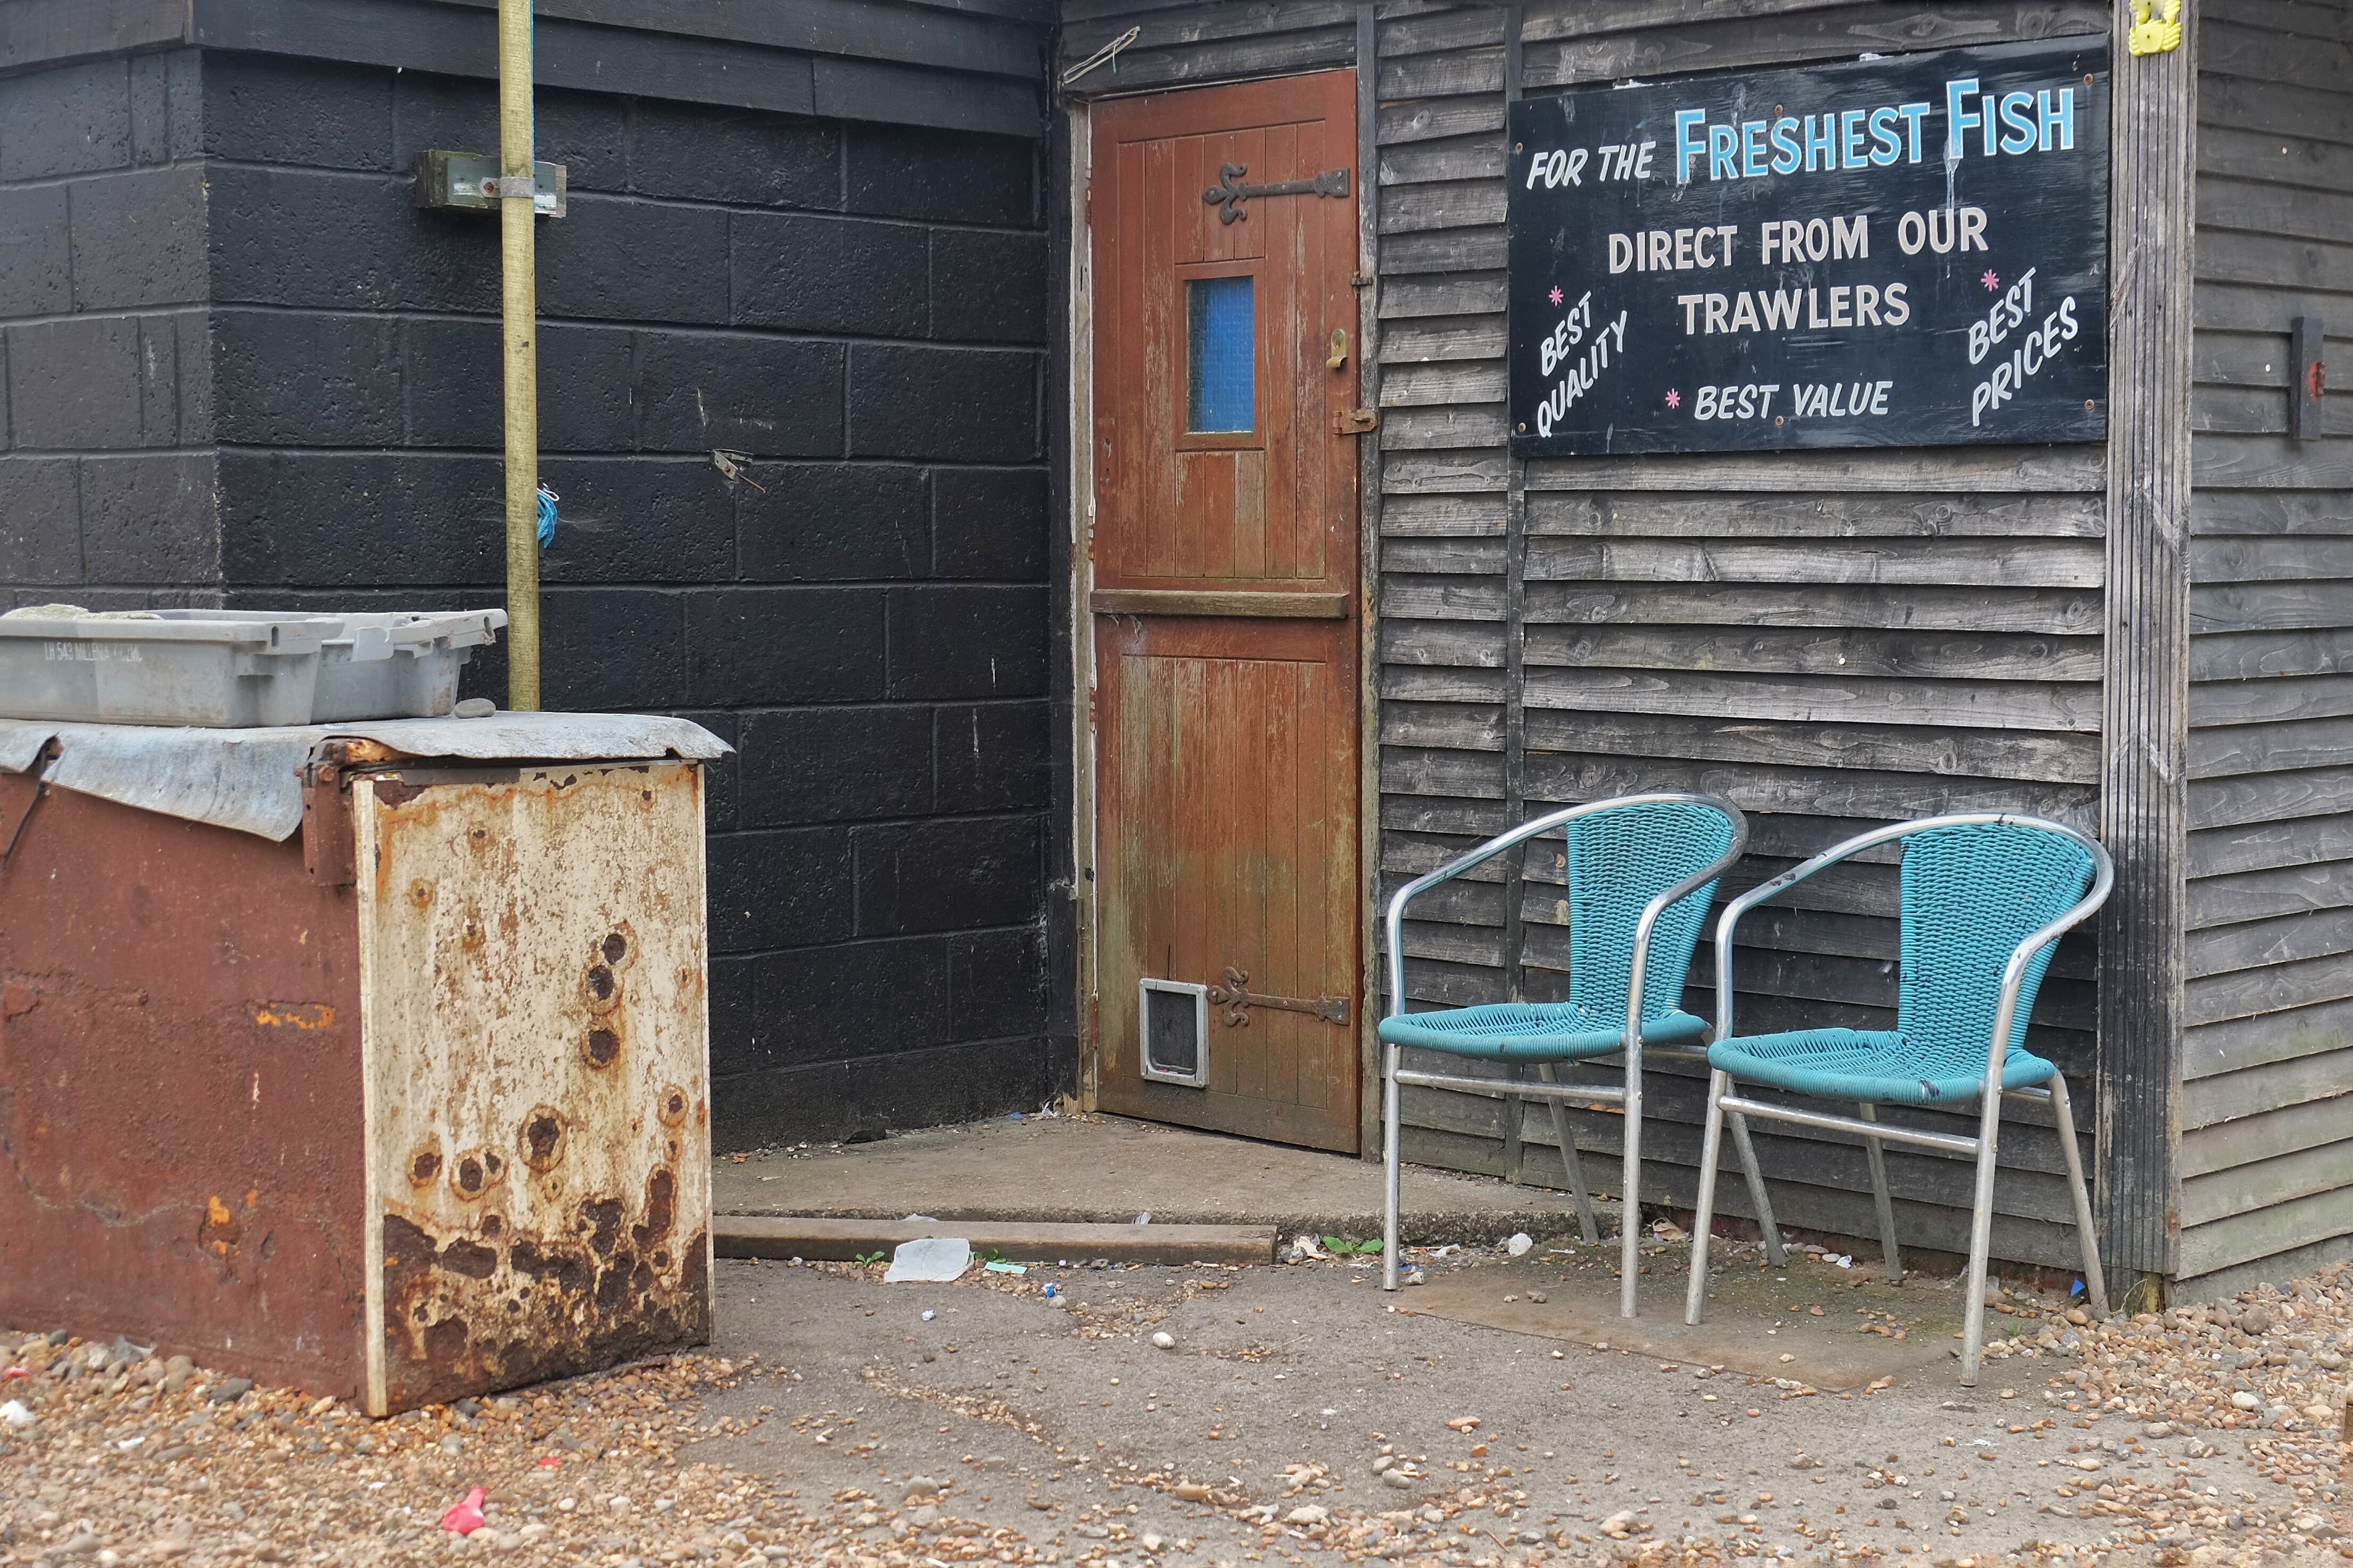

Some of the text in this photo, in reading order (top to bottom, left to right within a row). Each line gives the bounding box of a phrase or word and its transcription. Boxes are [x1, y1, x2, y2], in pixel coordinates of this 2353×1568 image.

[1526, 78, 2076, 189] FOR THE FRESHEST FISH
[1609, 207, 1988, 273] DIRECT FROM OUR
[1541, 291, 1592, 376] BEST
[1678, 283, 1911, 335] TRAWLERS
[1968, 267, 2036, 364] BEST
[1537, 310, 1628, 437] QUALITY
[1695, 381, 1893, 420] BEST VALUE
[1972, 296, 2078, 427] PRICES
